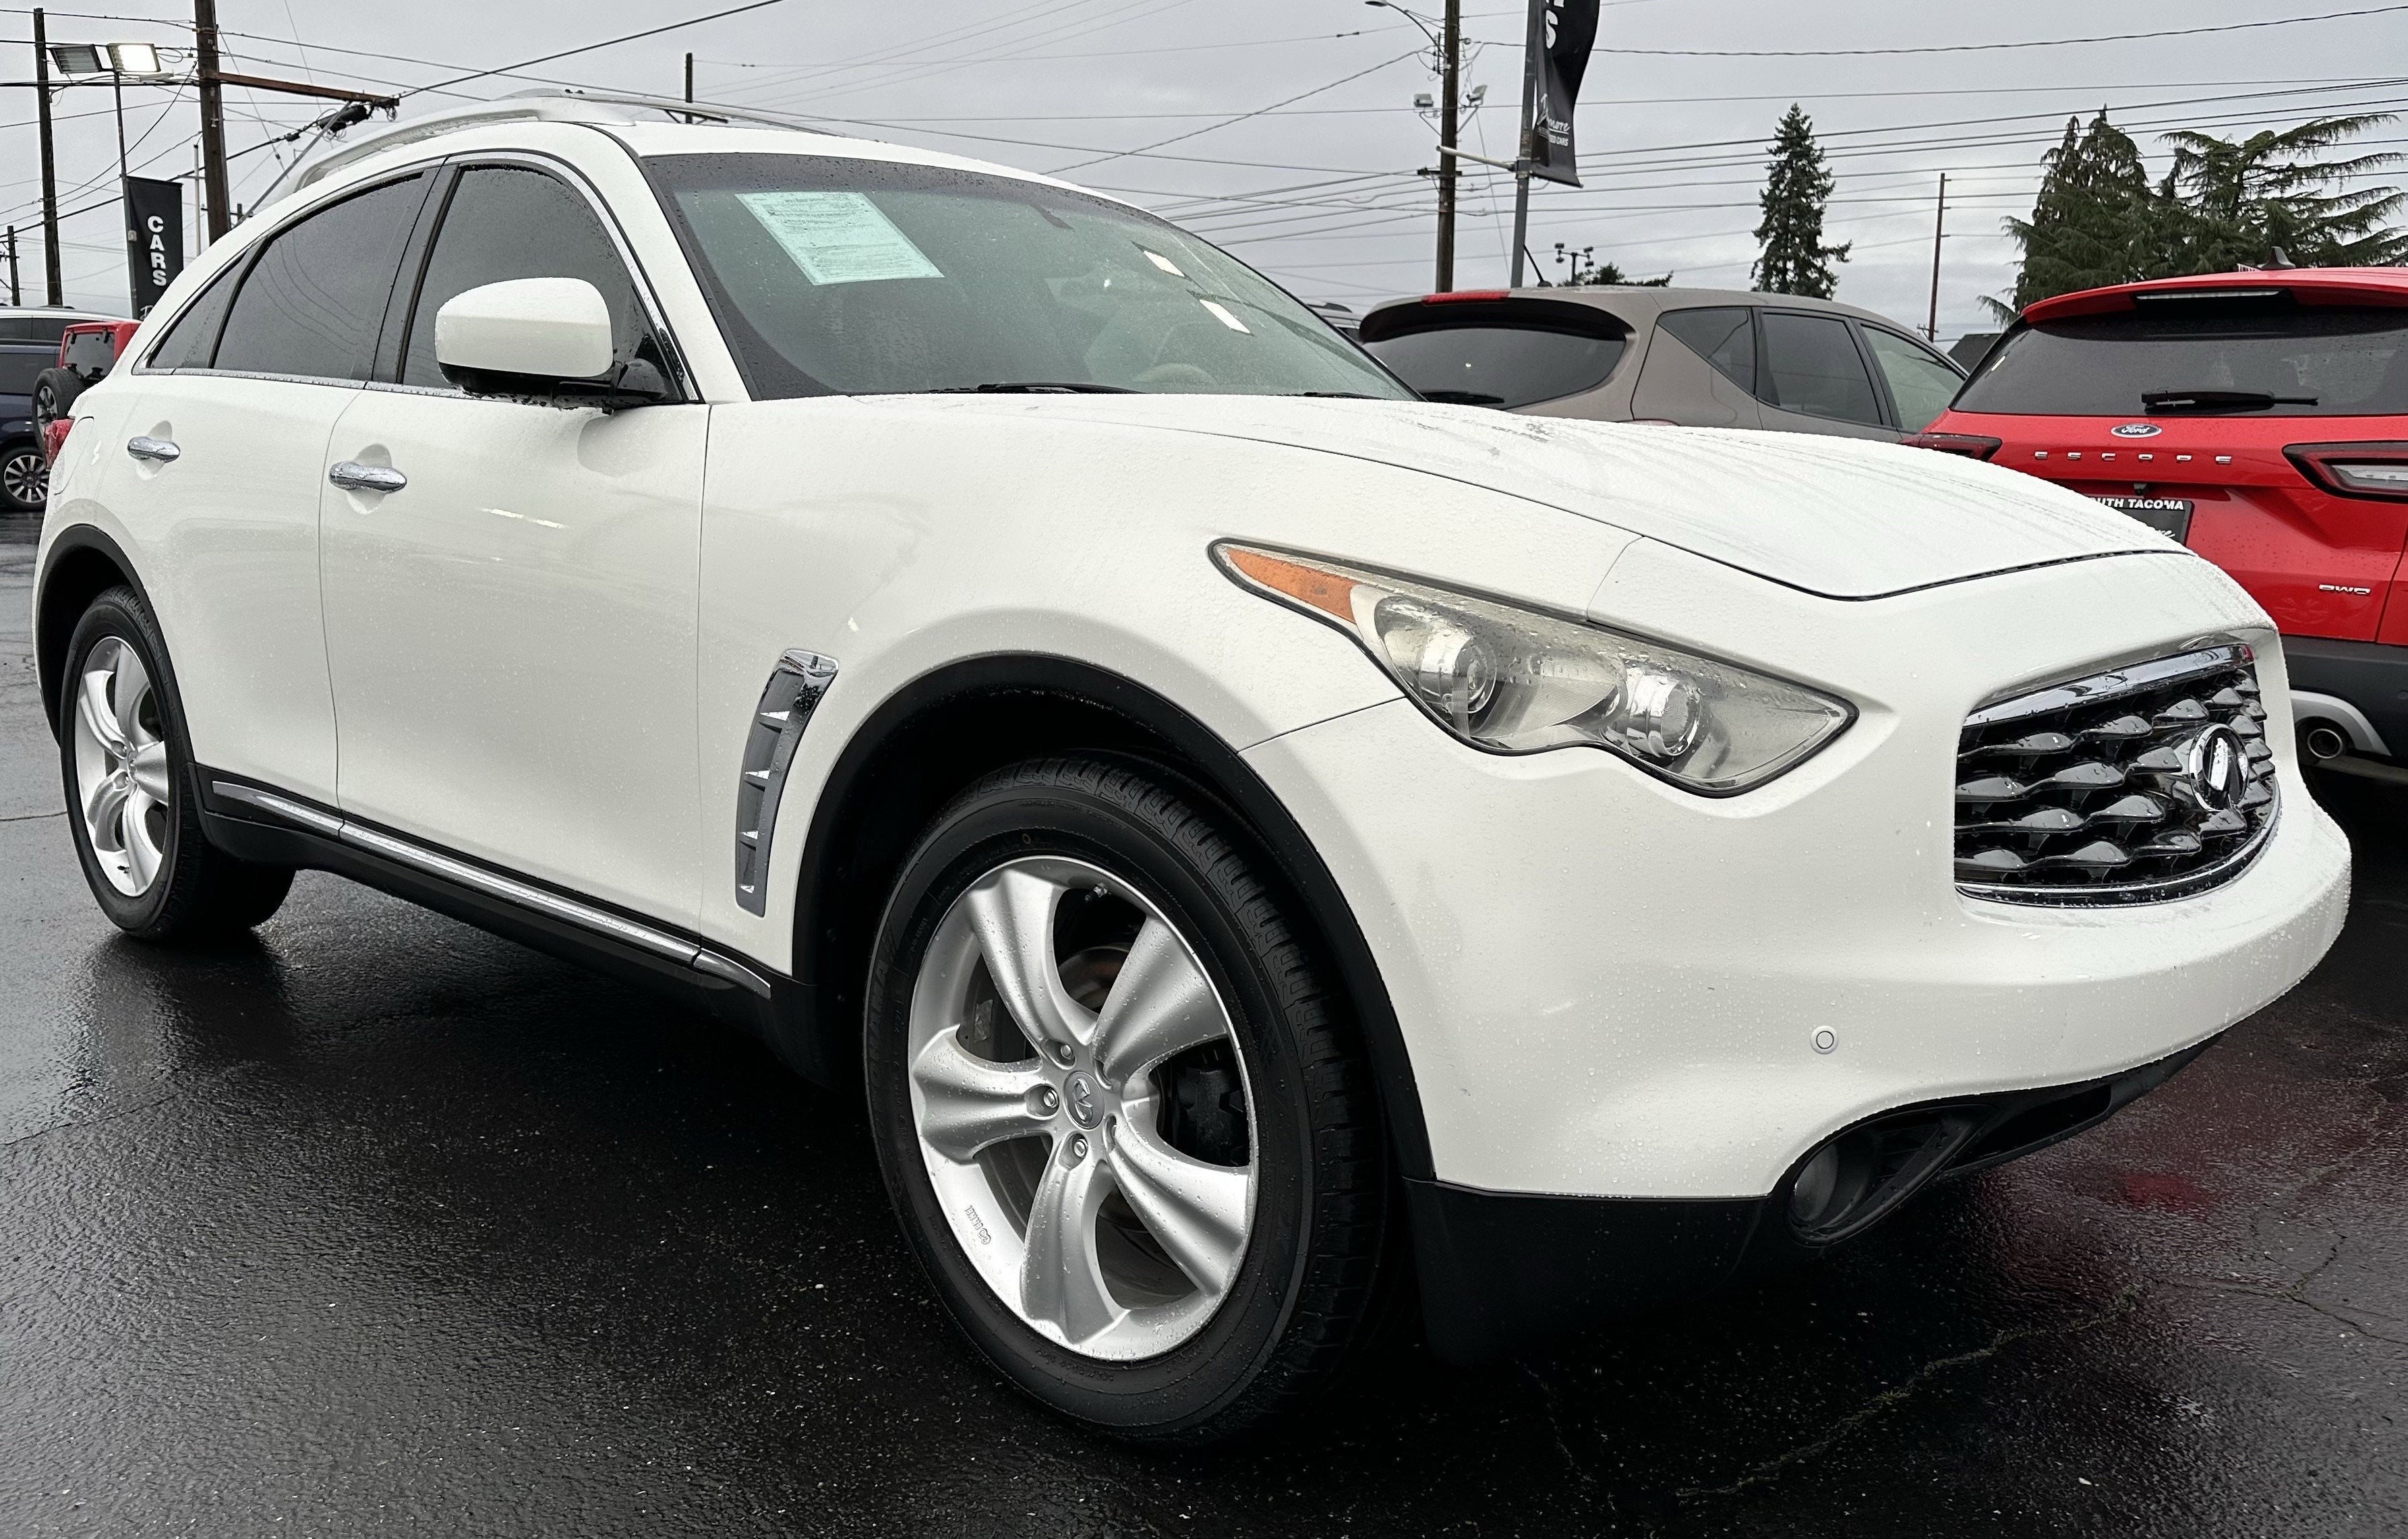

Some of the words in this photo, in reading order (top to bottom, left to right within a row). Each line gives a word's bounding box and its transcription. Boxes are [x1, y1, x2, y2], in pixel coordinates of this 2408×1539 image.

[147, 215, 167, 287] CARS
[2121, 425, 2150, 434] Ford
[2034, 451, 2232, 464] ESCAPE
[2128, 498, 2184, 510] TACOMA
